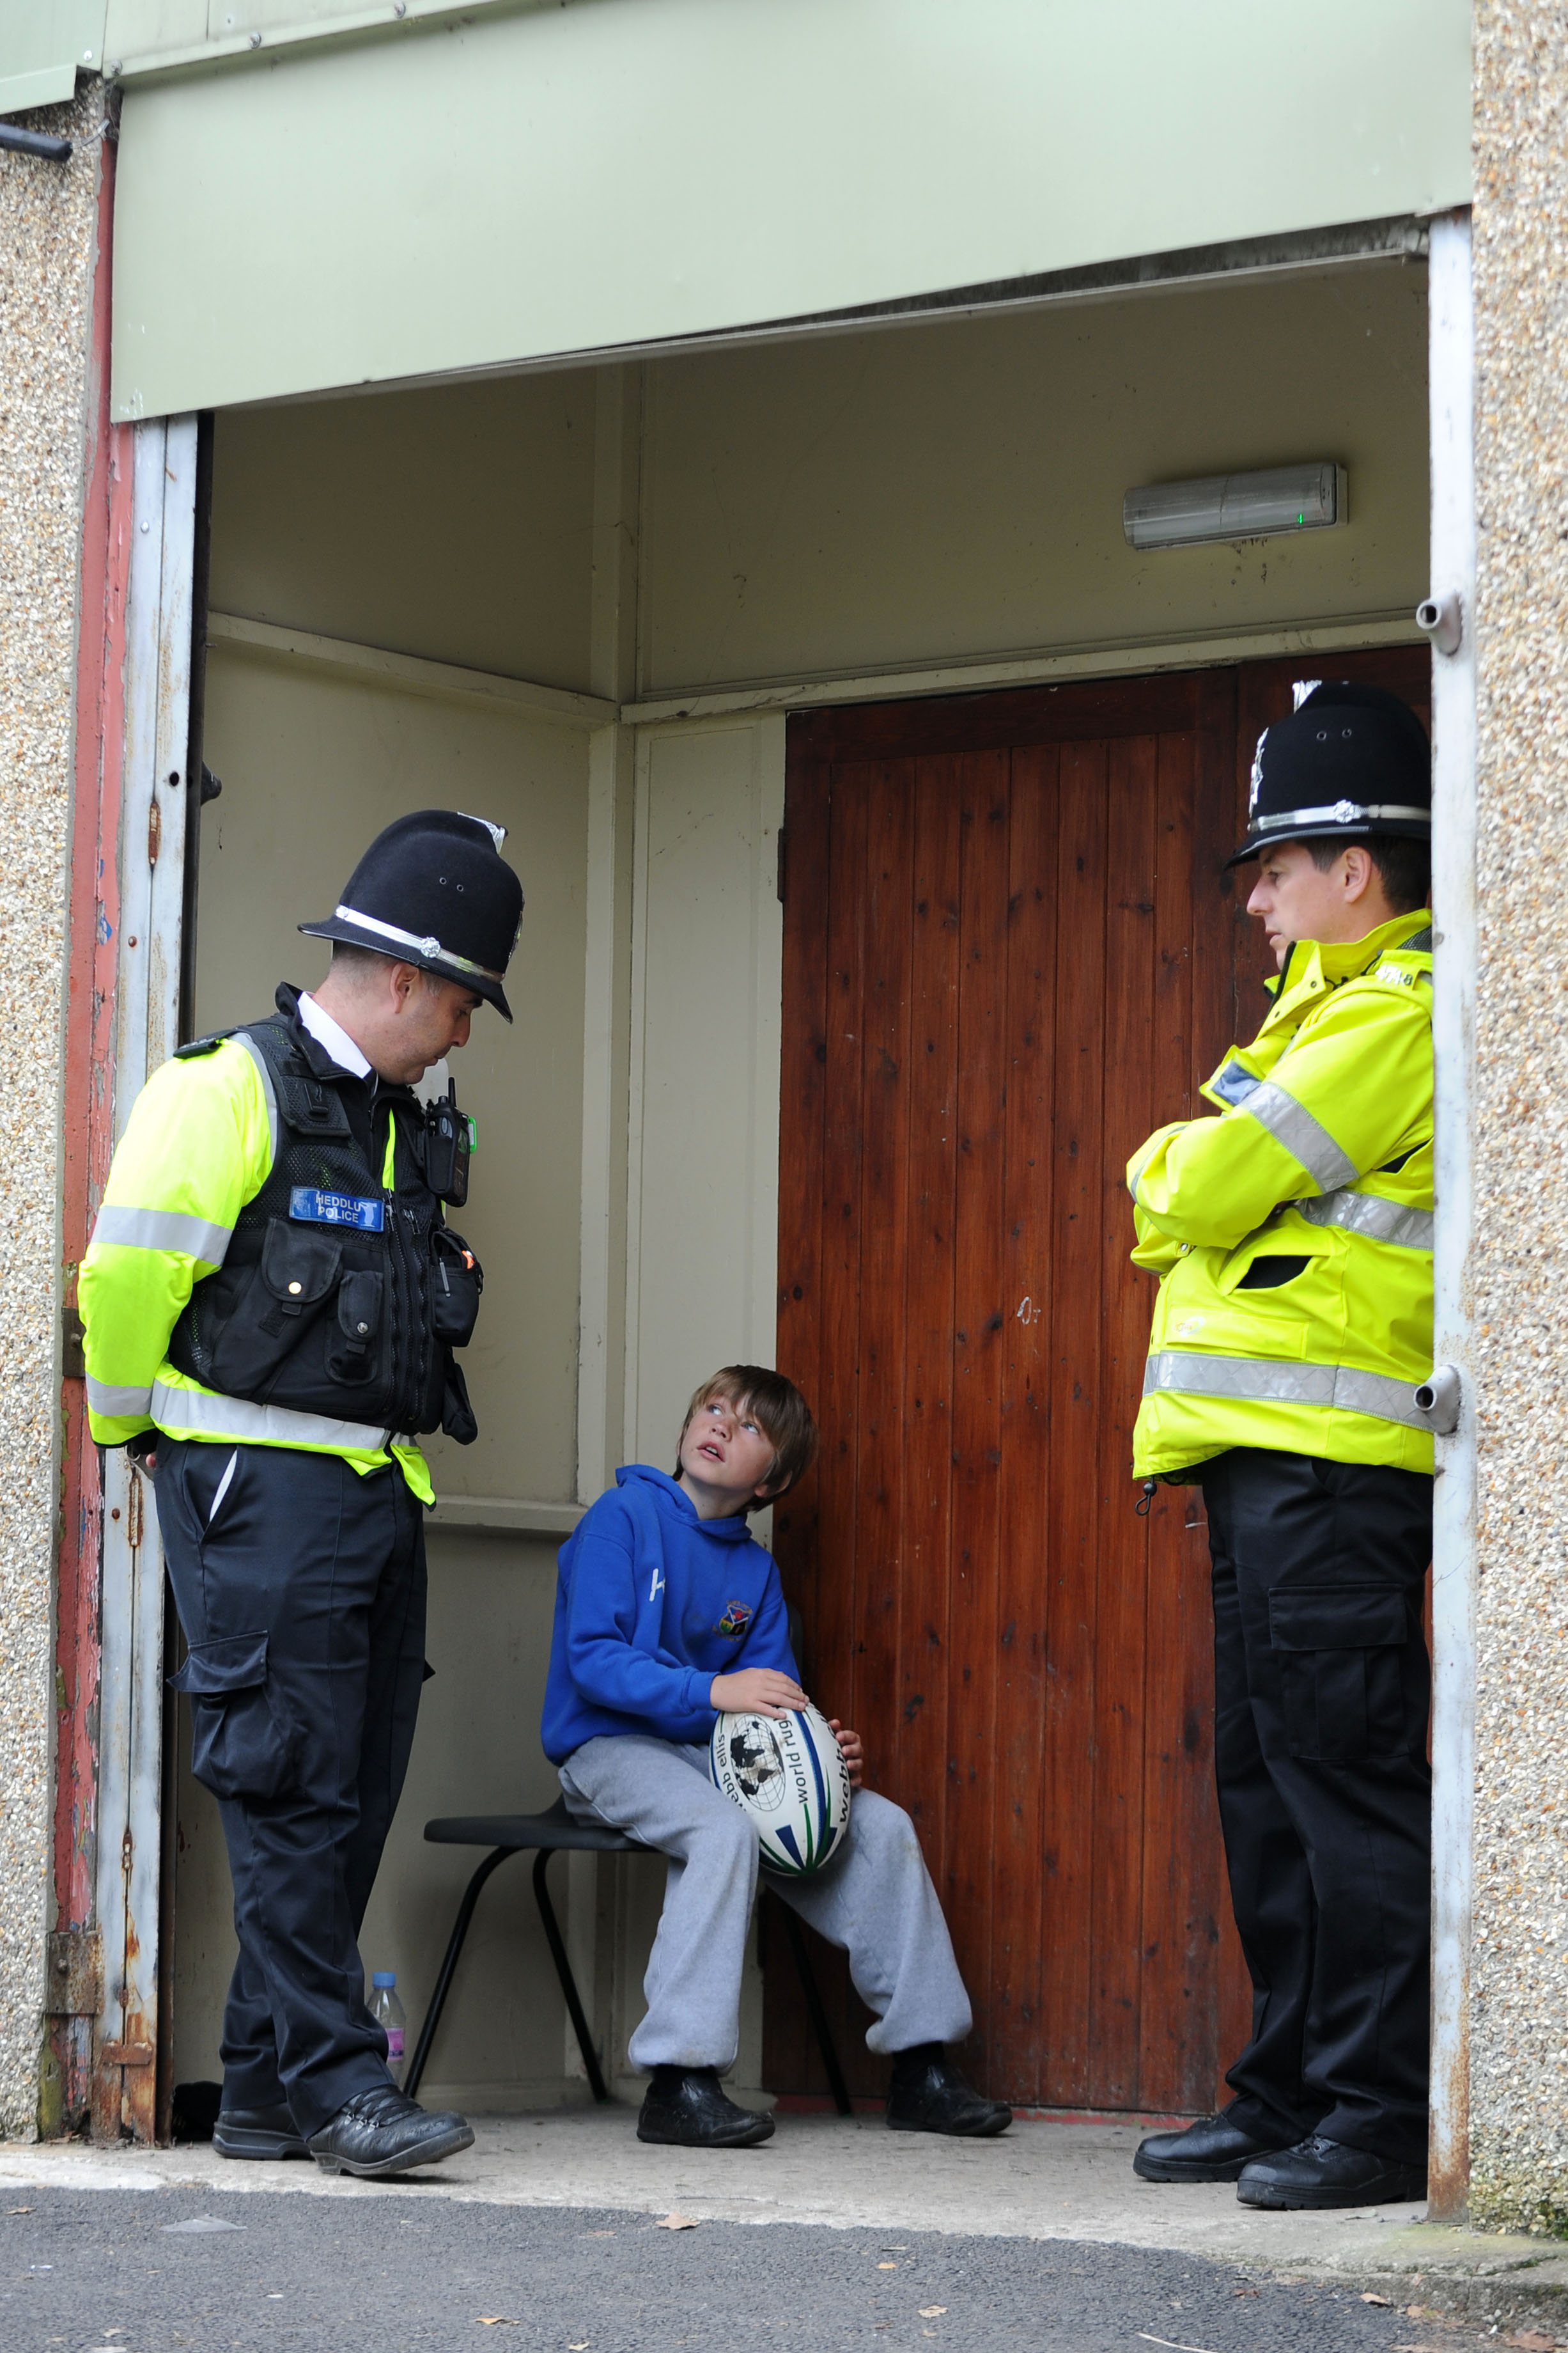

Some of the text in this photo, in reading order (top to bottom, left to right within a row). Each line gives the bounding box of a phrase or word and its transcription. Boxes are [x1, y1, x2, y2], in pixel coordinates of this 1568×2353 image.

[315, 1193, 361, 1212] HEDDLU
[317, 1206, 359, 1223] POLICE
[773, 1716, 808, 1804] world rug
[722, 1772, 747, 1811] ebb
